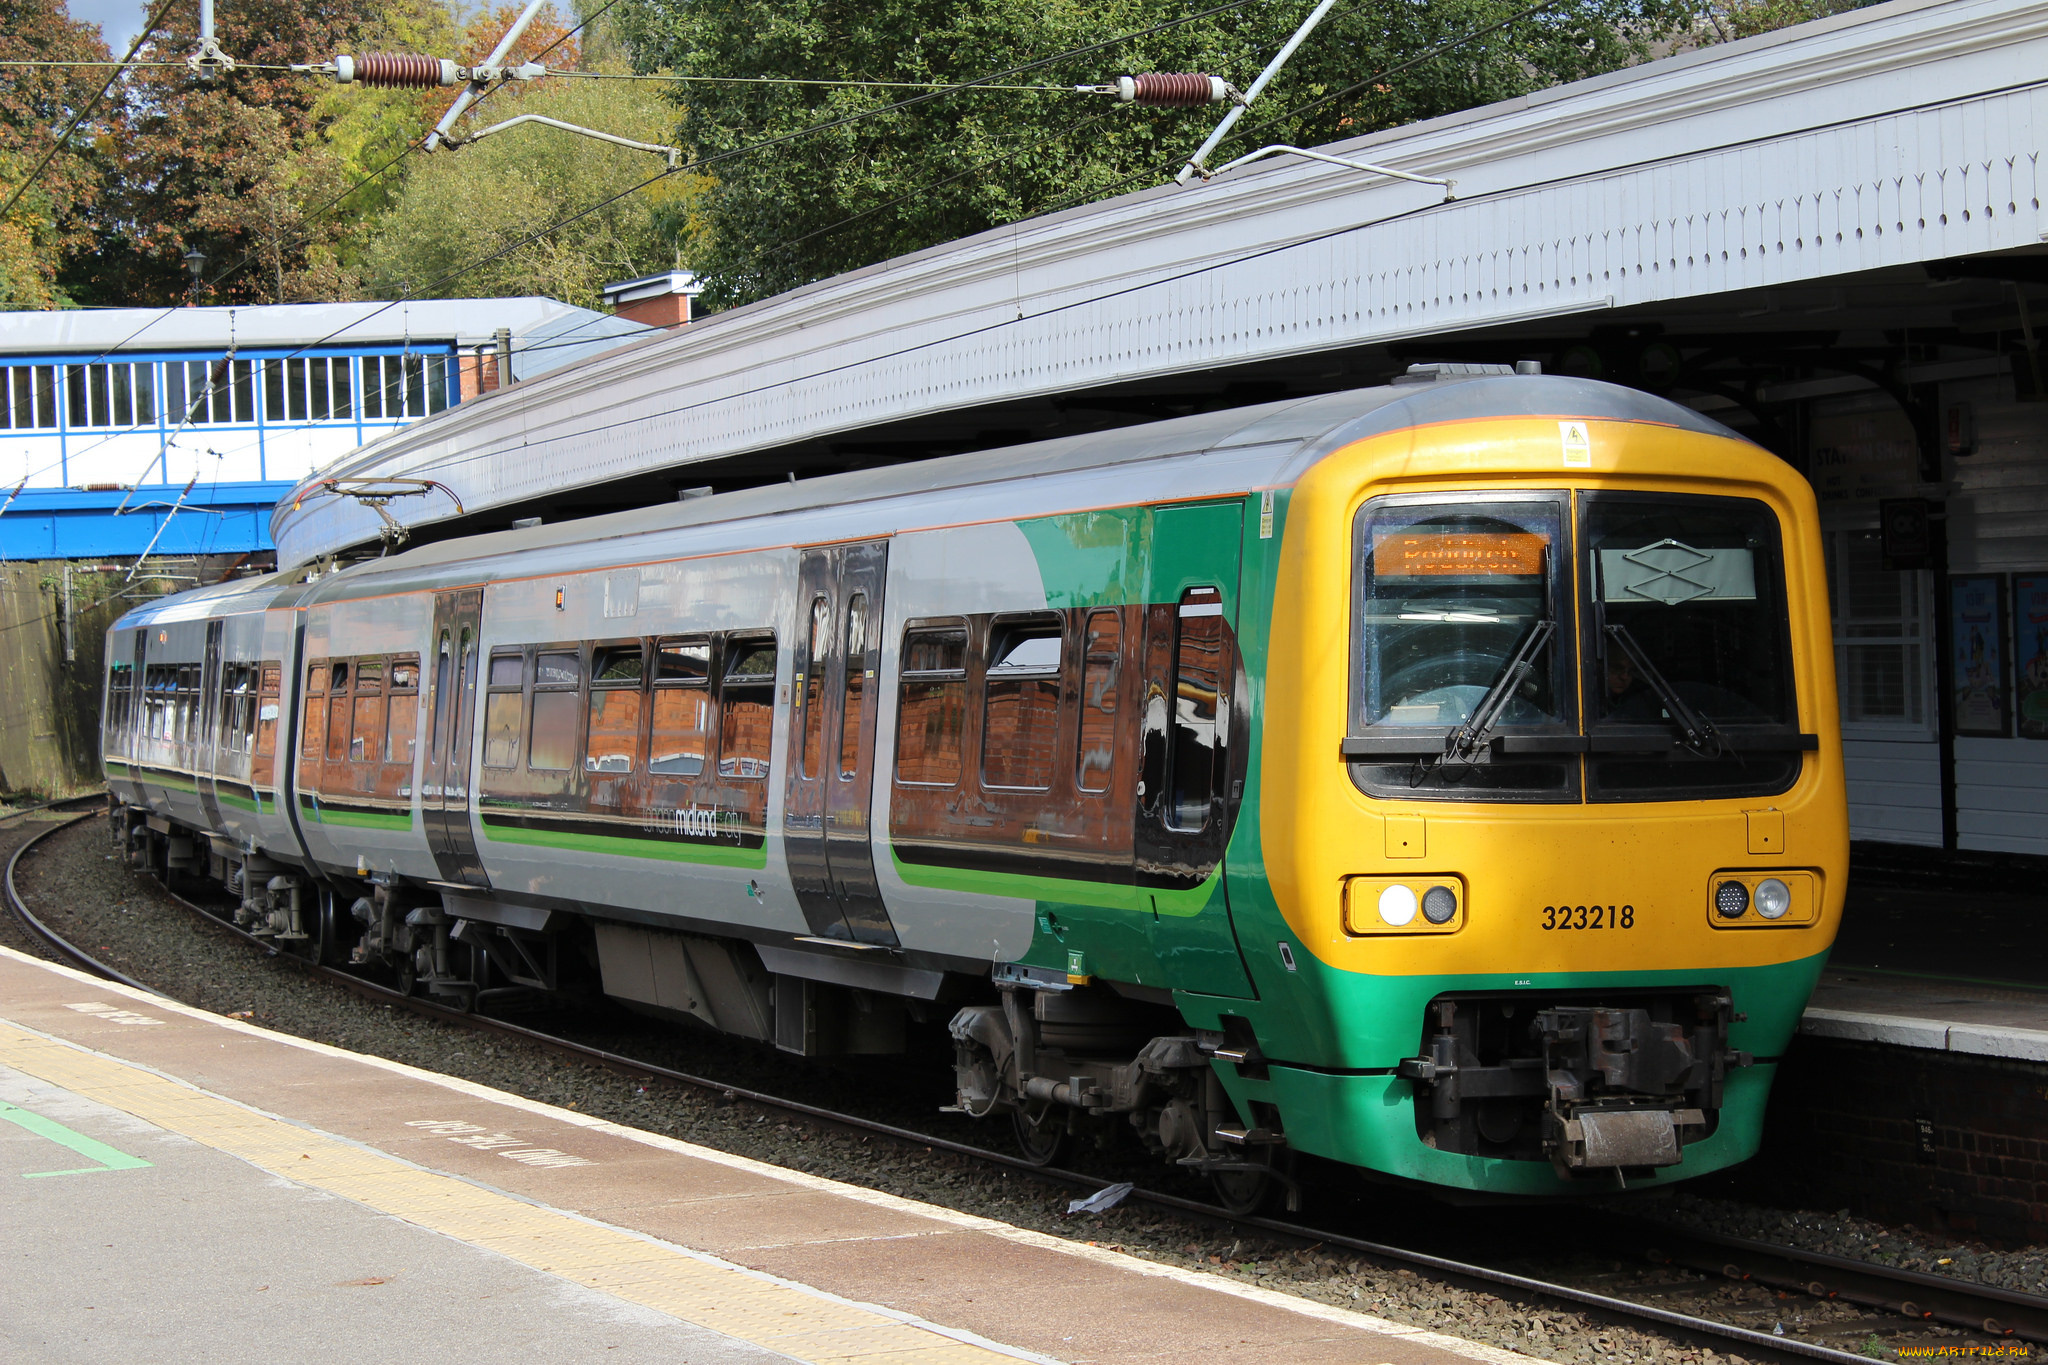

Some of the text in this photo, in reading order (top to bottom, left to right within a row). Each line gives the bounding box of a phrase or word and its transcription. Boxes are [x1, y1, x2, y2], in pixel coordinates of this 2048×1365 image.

[675, 801, 717, 837] midland
[724, 801, 743, 846] city
[1541, 904, 1635, 931] 323218
[404, 1119, 600, 1169] MIND THE GAP
